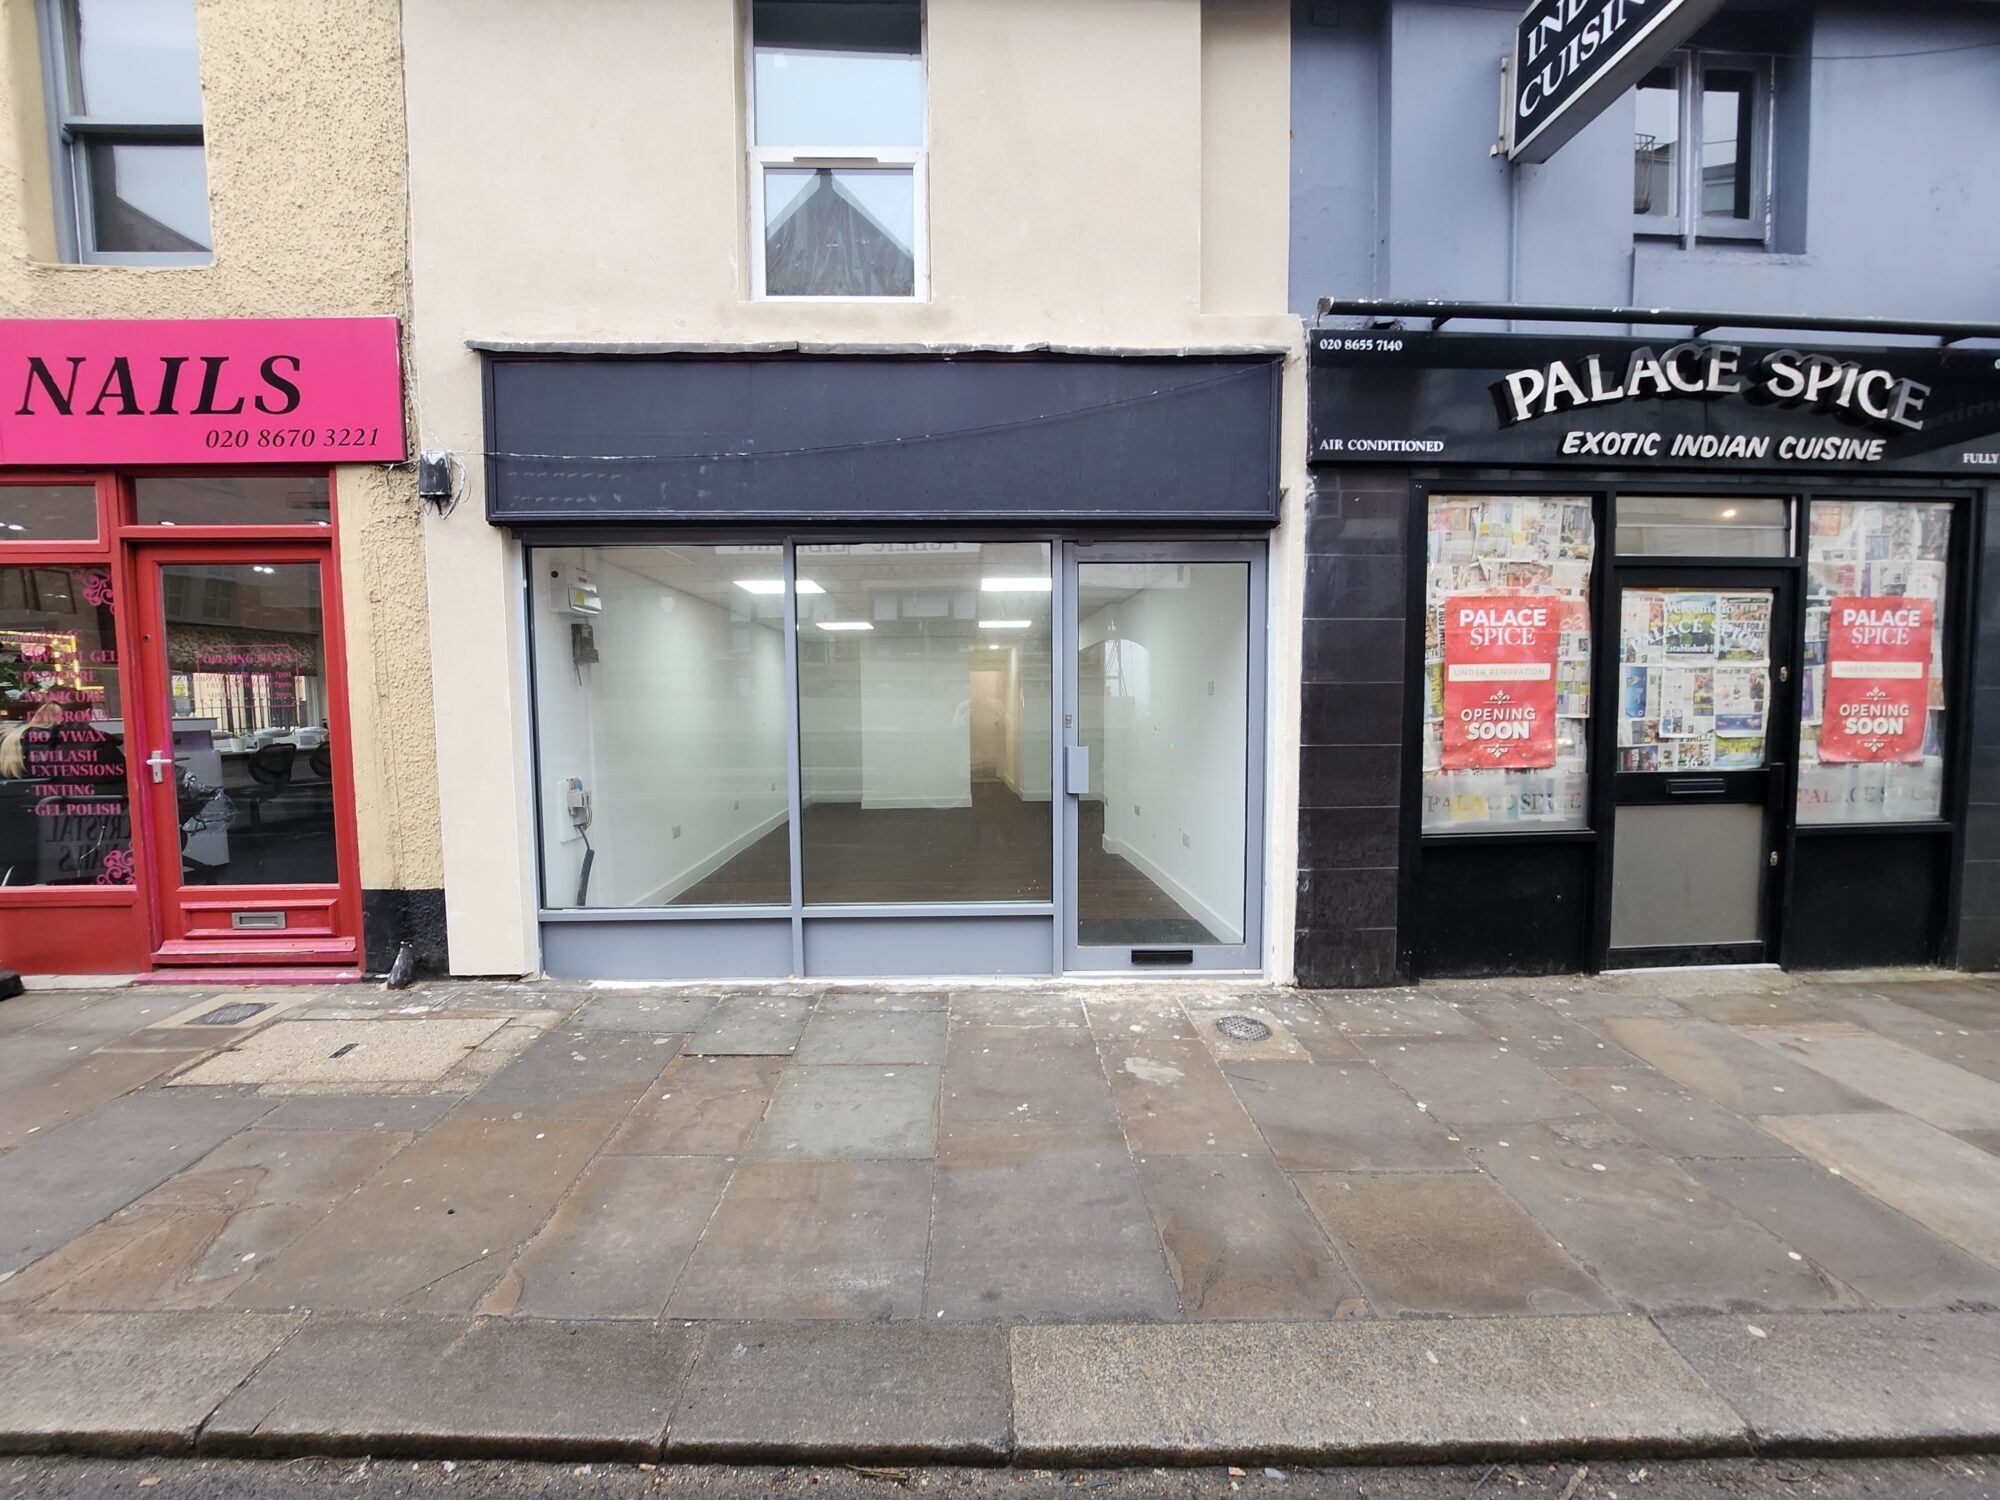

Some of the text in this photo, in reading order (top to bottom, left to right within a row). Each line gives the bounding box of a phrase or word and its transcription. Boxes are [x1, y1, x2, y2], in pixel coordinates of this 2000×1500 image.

[1319, 338, 1404, 352] 020 8655 7140
[15, 354, 302, 416] NAILS
[1505, 342, 1932, 431] PALACE SPICE
[205, 427, 379, 448] 020 8670 3221
[1319, 438, 1445, 452] AIR CONDITIONED
[1562, 431, 1887, 461] EXOTIC INDIAN CUISINE
[1962, 452, 2000, 464] FULLY
[1459, 608, 1547, 627] PALACE
[1842, 609, 1921, 627] PALACE
[1470, 626, 1537, 646] SPICE
[1629, 618, 1762, 654] PALACE SPICE
[1851, 626, 1910, 646] SPICE
[1461, 707, 1537, 722] OPENING
[1839, 703, 1910, 717] OPENING
[1467, 721, 1530, 740] SOON
[1844, 717, 1904, 735] SOON
[28, 730, 107, 743] BOYWAX
[29, 750, 98, 763] EYELASH
[31, 764, 125, 777] EXTENSIONS
[32, 784, 96, 797] TINTING
[34, 803, 122, 816] GEL POLISH
